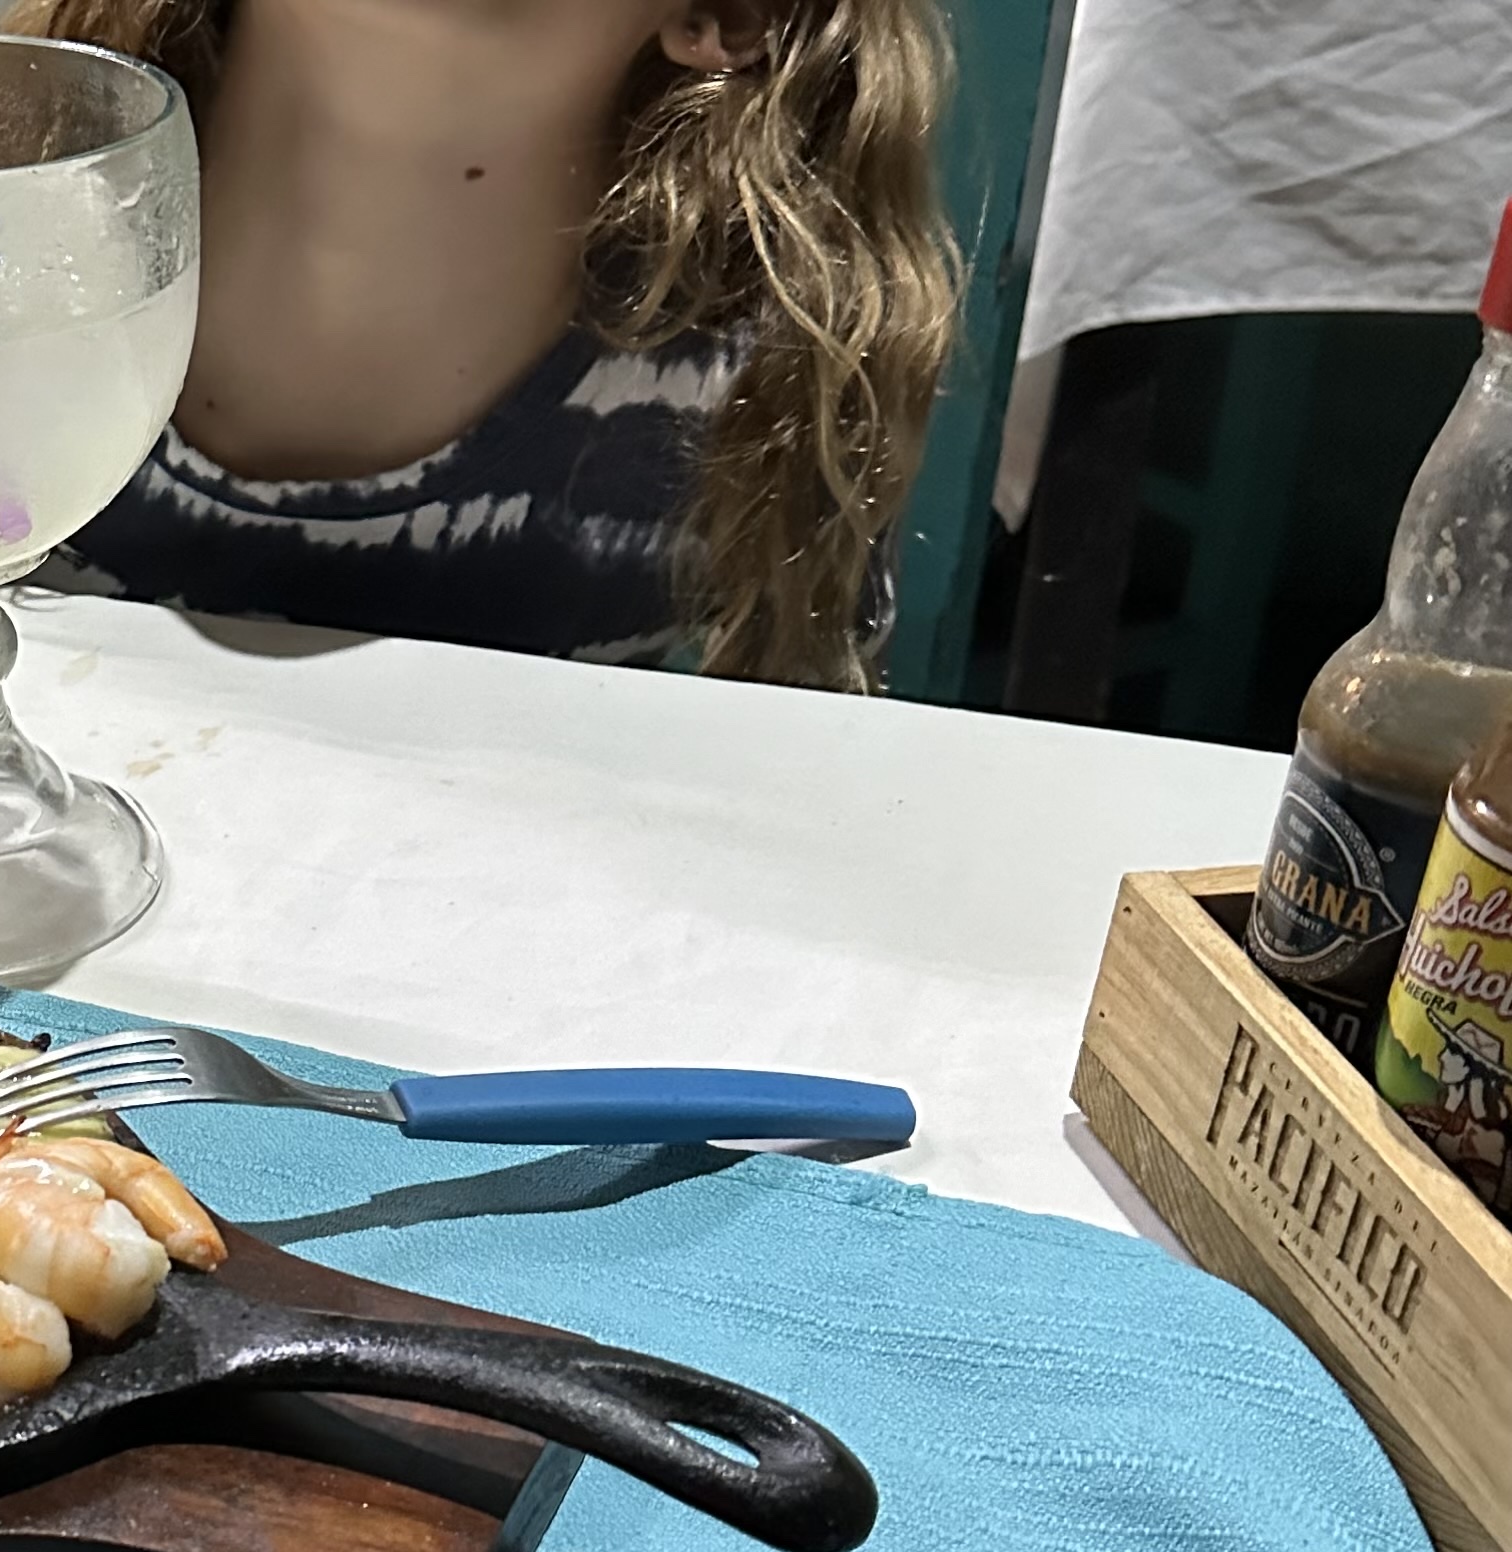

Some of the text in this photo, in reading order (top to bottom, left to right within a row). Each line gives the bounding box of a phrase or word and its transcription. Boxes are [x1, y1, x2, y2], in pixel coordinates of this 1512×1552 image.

[1271, 850, 1372, 935] GRANA
[1429, 873, 1512, 936] Sals
[1404, 979, 1458, 1015] NEGRA
[1268, 1061, 1376, 1186] CERVEZA
[1205, 1021, 1428, 1335] PACIFICO
